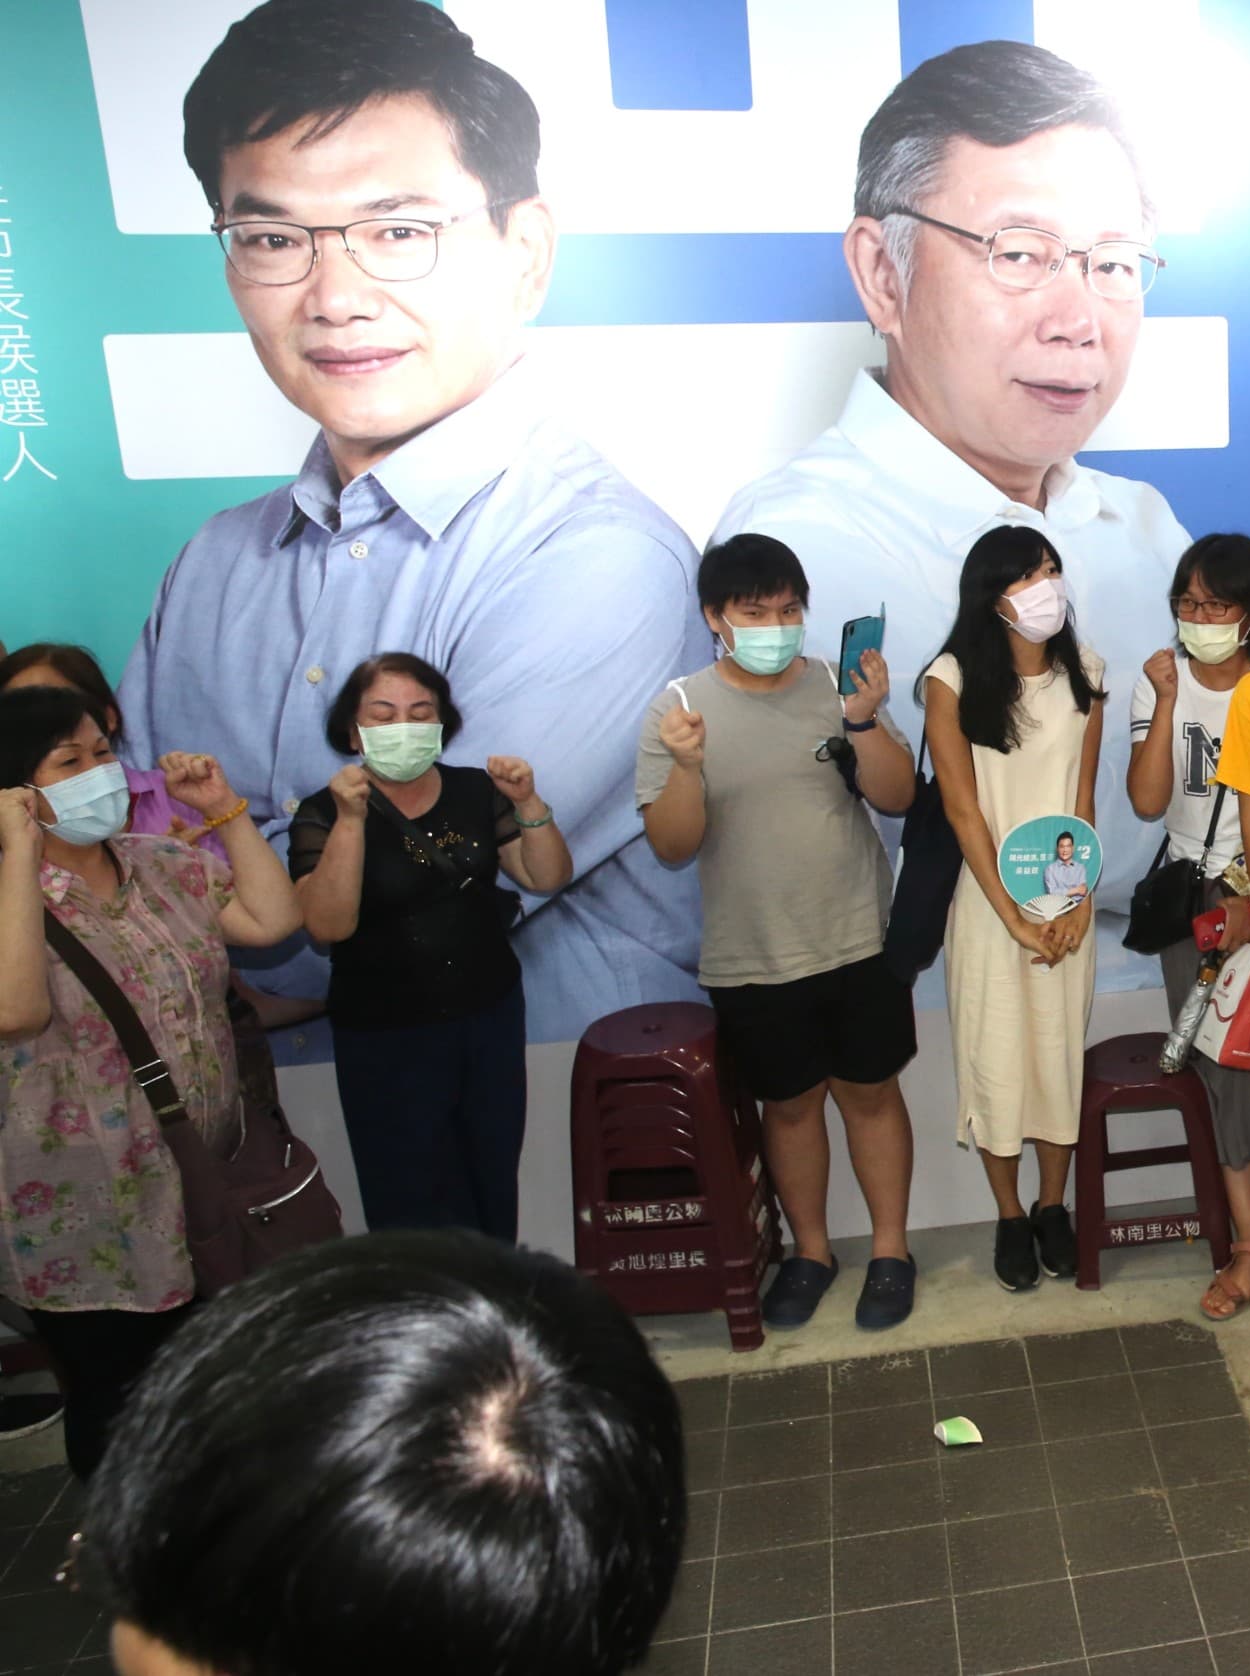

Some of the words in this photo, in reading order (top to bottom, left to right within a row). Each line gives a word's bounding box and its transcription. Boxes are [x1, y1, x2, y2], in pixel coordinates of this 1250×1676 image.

[1110, 1220, 1200, 1243] 林南里公物
